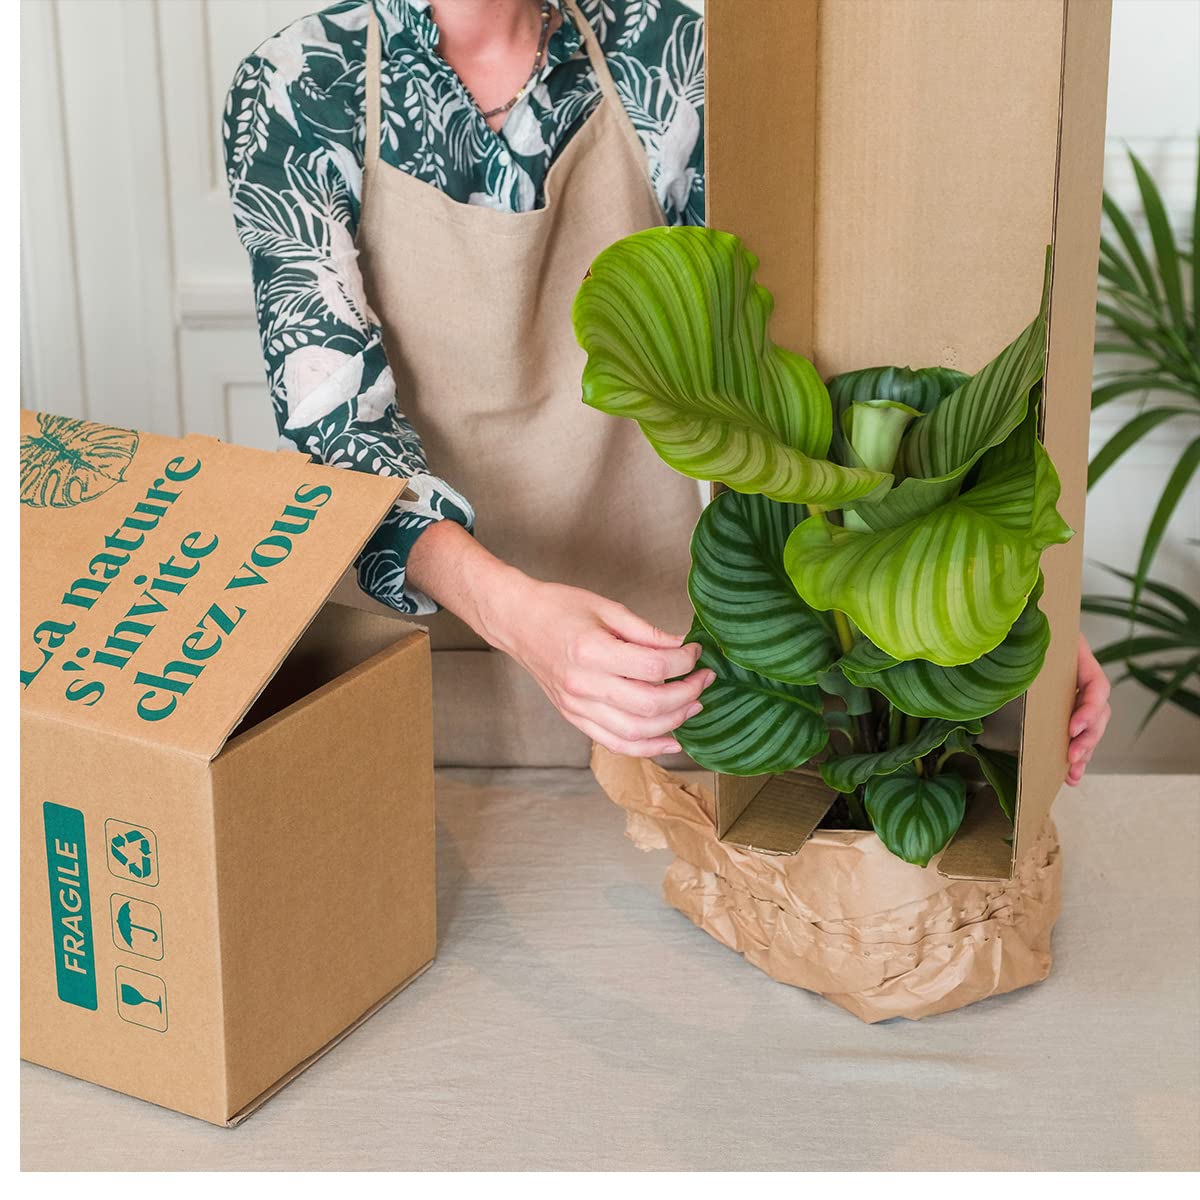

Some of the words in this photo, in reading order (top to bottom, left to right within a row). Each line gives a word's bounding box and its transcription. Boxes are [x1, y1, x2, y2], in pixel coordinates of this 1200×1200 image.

[61, 456, 201, 611] nature
[134, 602, 247, 721] chez
[224, 483, 332, 591] vous
[62, 531, 218, 706] s'invite
[54, 838, 87, 976] FRAGILE
